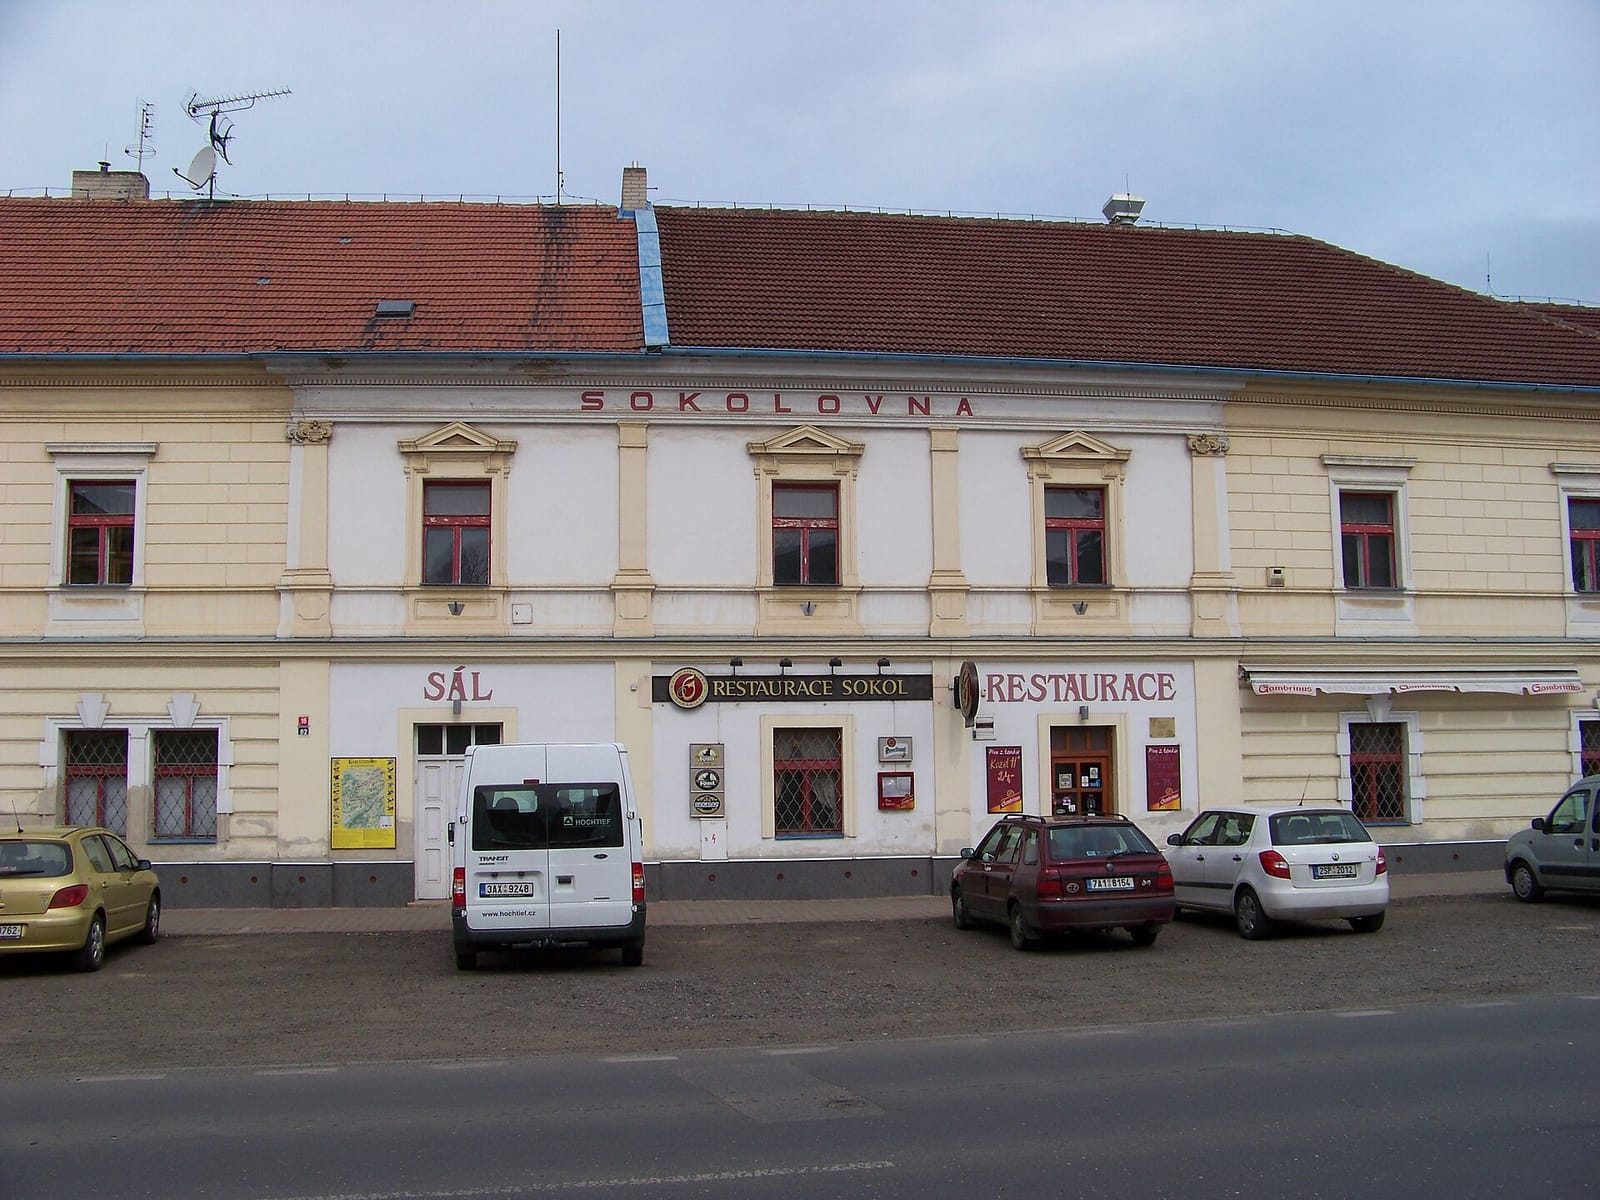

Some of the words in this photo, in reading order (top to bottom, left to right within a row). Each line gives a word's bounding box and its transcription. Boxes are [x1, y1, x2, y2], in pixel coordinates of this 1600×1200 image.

[581, 390, 974, 417] SOKOLOVNA
[423, 665, 493, 701] SÁL
[986, 672, 1177, 703] RESTAURACE
[712, 679, 833, 697] RESTAURACE
[841, 679, 909, 696] SOKOL
[1258, 684, 1313, 693] Gambrinus
[575, 818, 611, 826] HOCHTIEF
[1336, 866, 1353, 874] 2012
[487, 884, 503, 894] 3AX
[508, 884, 529, 894] 9248
[481, 910, 536, 918] www.hochtief.cz
[0, 926, 18, 935] 762
